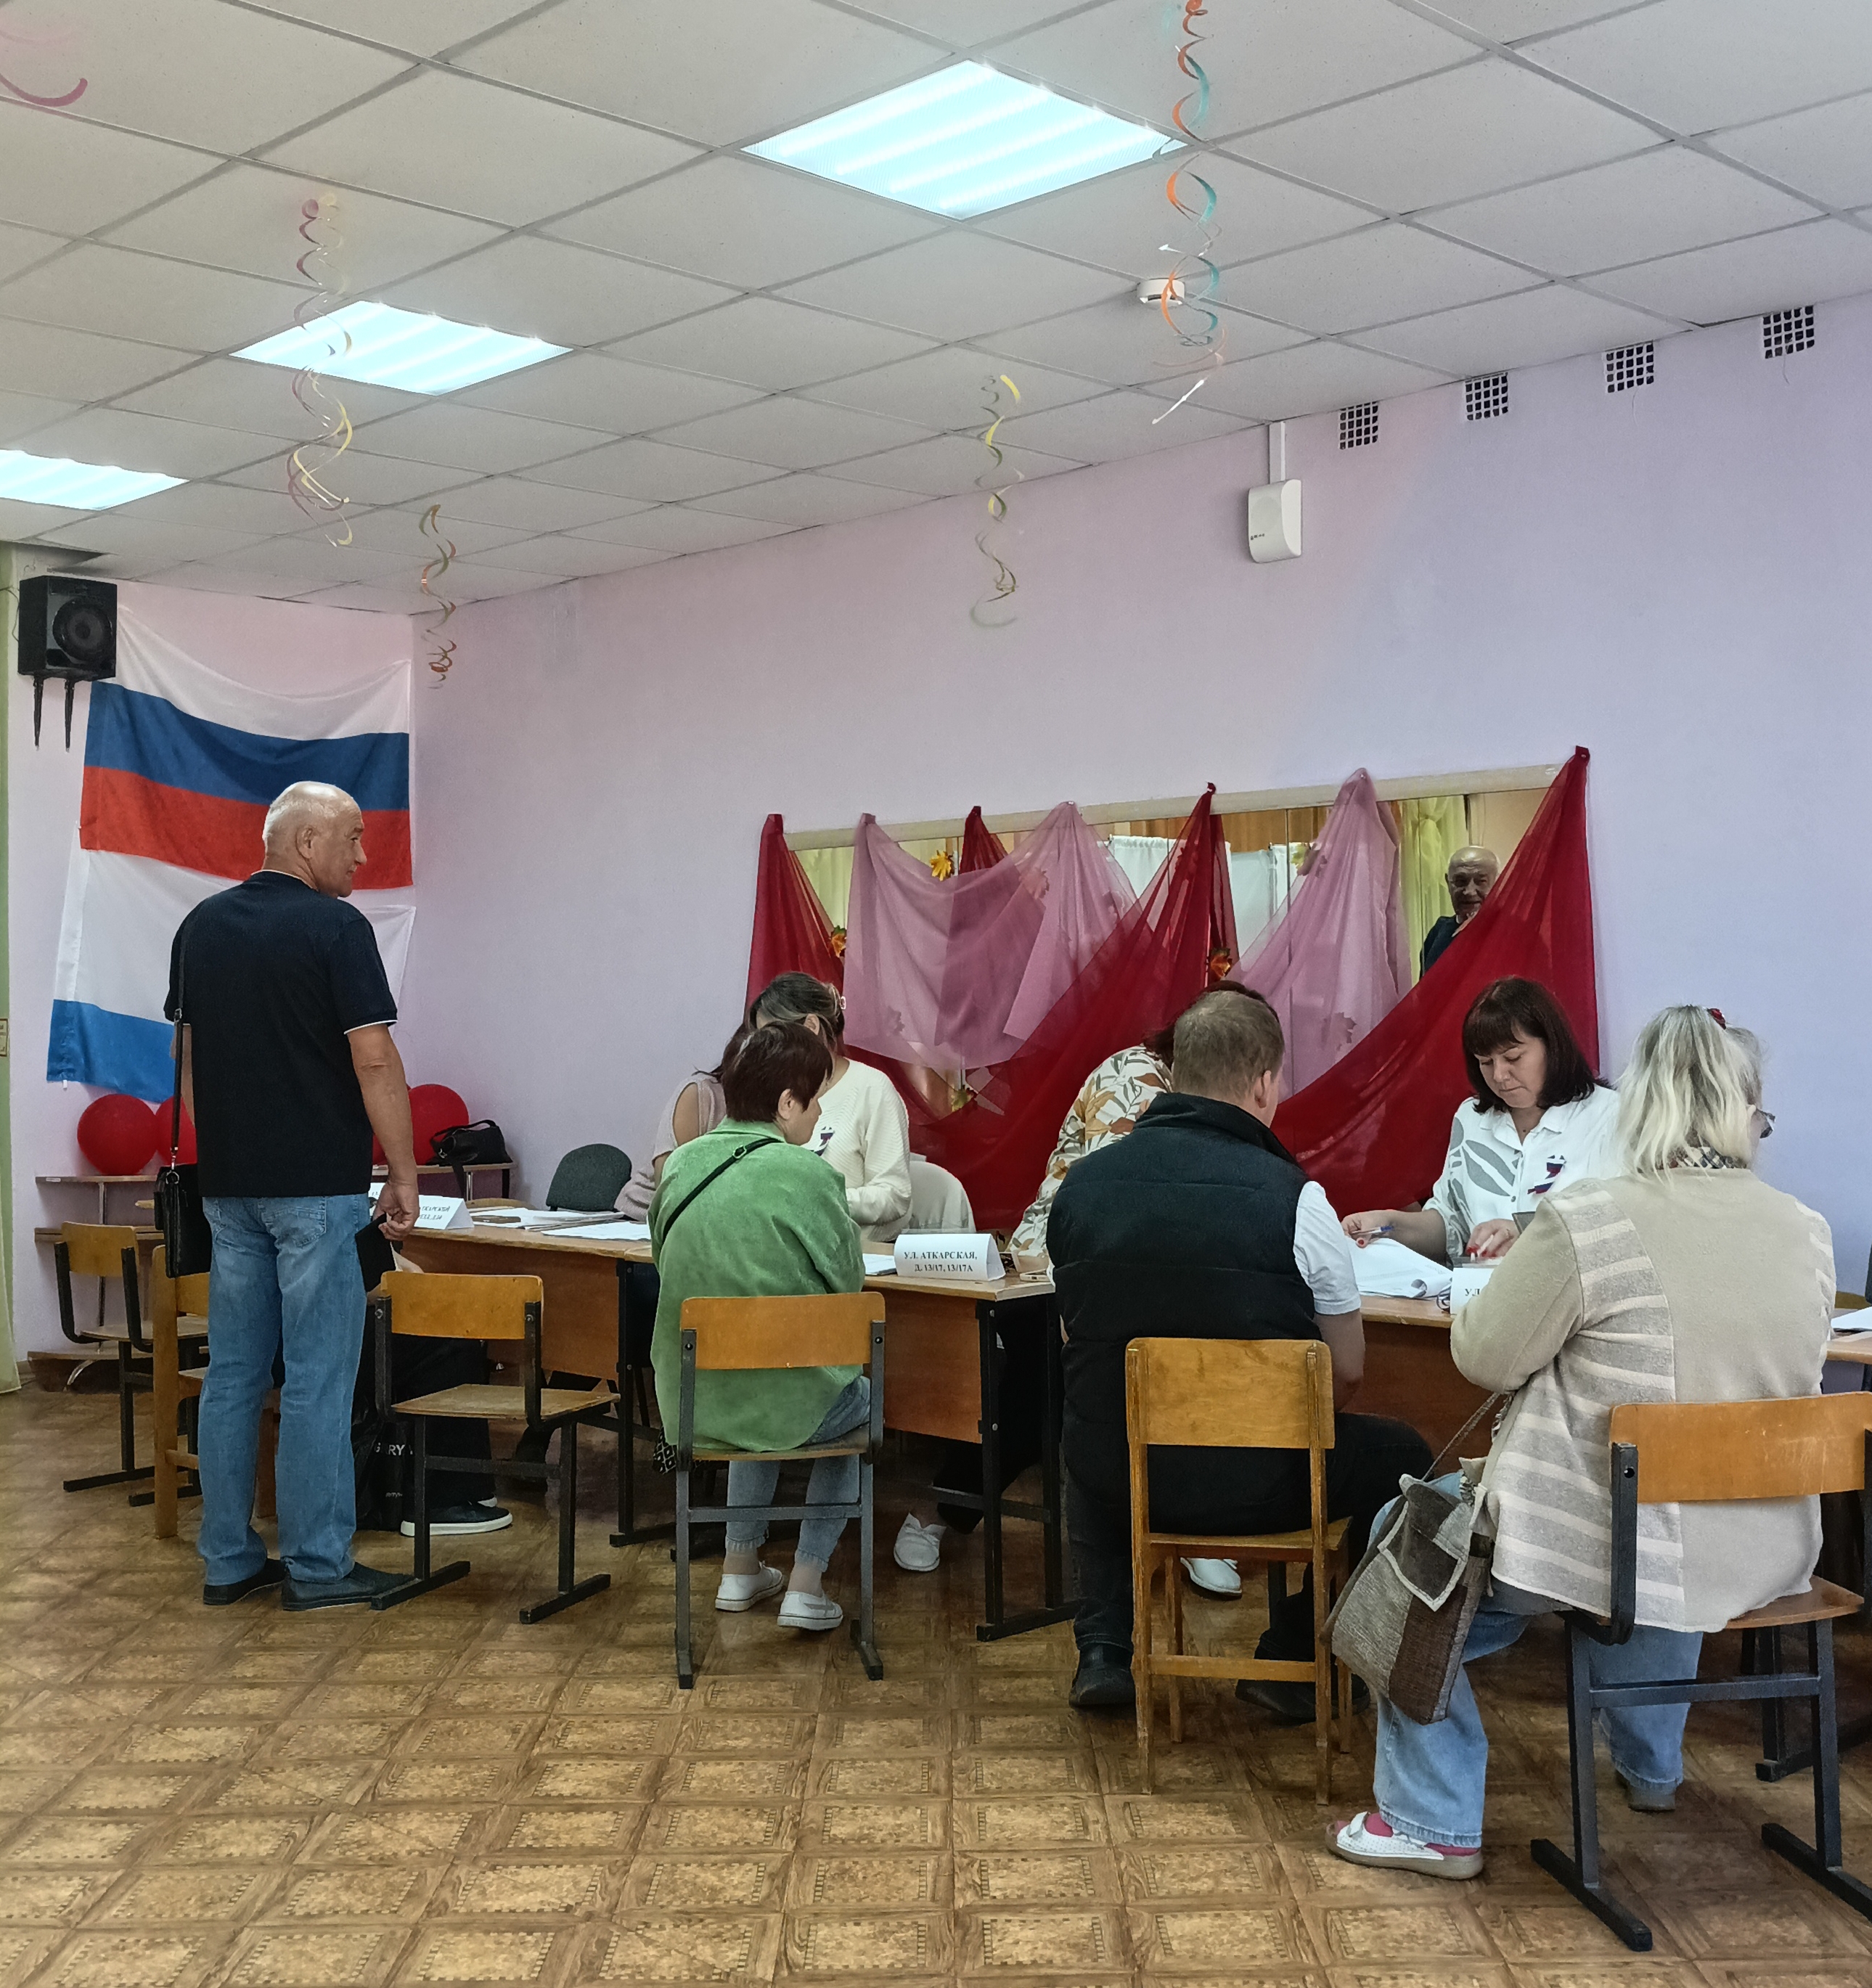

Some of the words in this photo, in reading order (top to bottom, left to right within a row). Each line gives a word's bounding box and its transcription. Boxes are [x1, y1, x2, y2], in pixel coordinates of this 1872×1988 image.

[920, 1251, 978, 1260] АТКАРСКАЯ,
[924, 1264, 946, 1272] 13/17,
[947, 1264, 973, 1272] 13/17А
